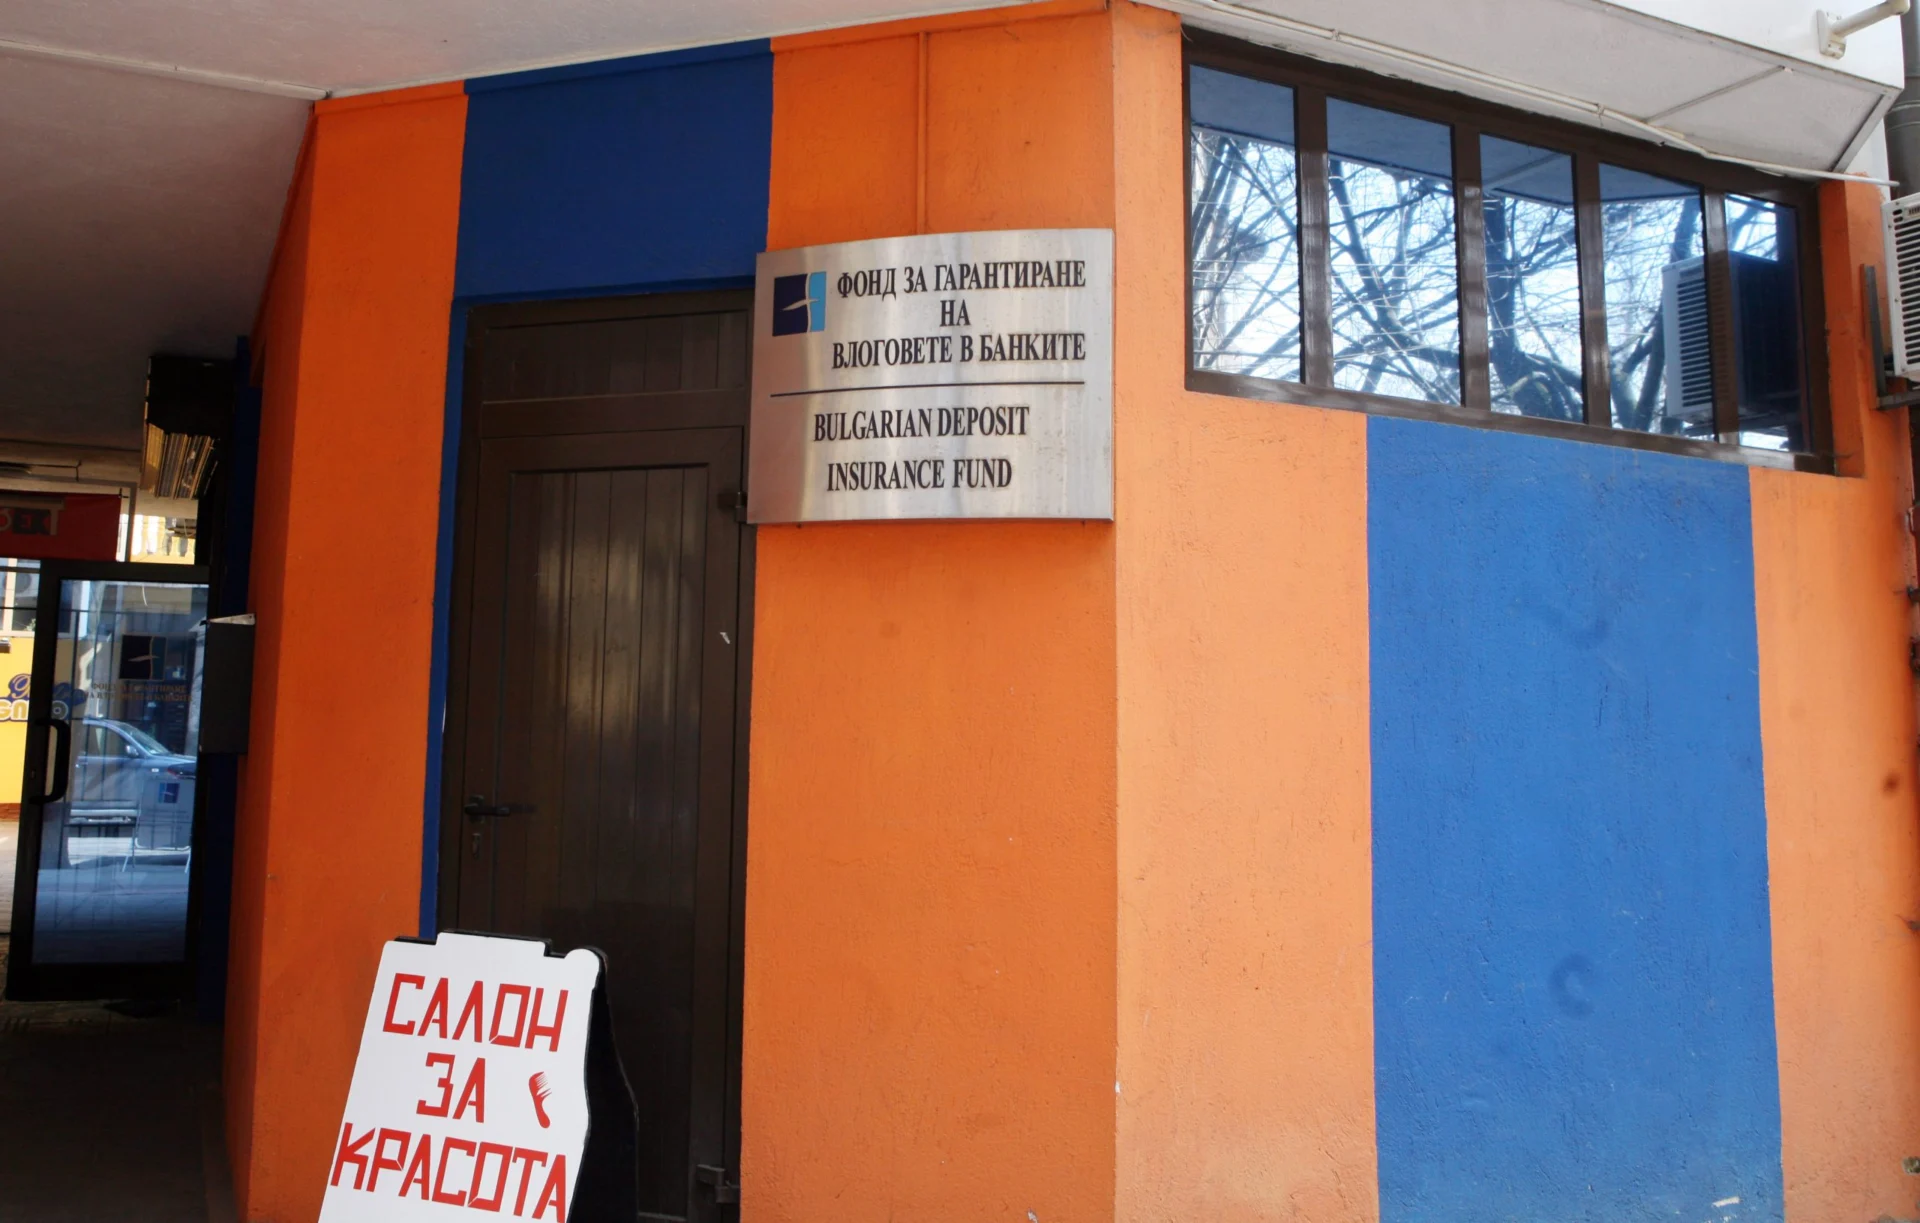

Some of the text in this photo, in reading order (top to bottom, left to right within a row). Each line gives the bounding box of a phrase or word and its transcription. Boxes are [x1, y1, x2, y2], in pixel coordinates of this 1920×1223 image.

[837, 260, 1087, 301] ФОНД ЗА ГАРАНТИРАНЕ
[939, 299, 971, 328] НА
[832, 333, 1087, 369] ВЛОГОВЕТЕ В БАНКИТЕ
[813, 406, 1030, 442] BULGARIAN DEPOSIT
[826, 458, 1012, 491] INSURANCE FUND
[382, 972, 569, 1052] САЛОН
[416, 1052, 486, 1123] ЗА
[330, 1122, 567, 1223] КРАСОТА
